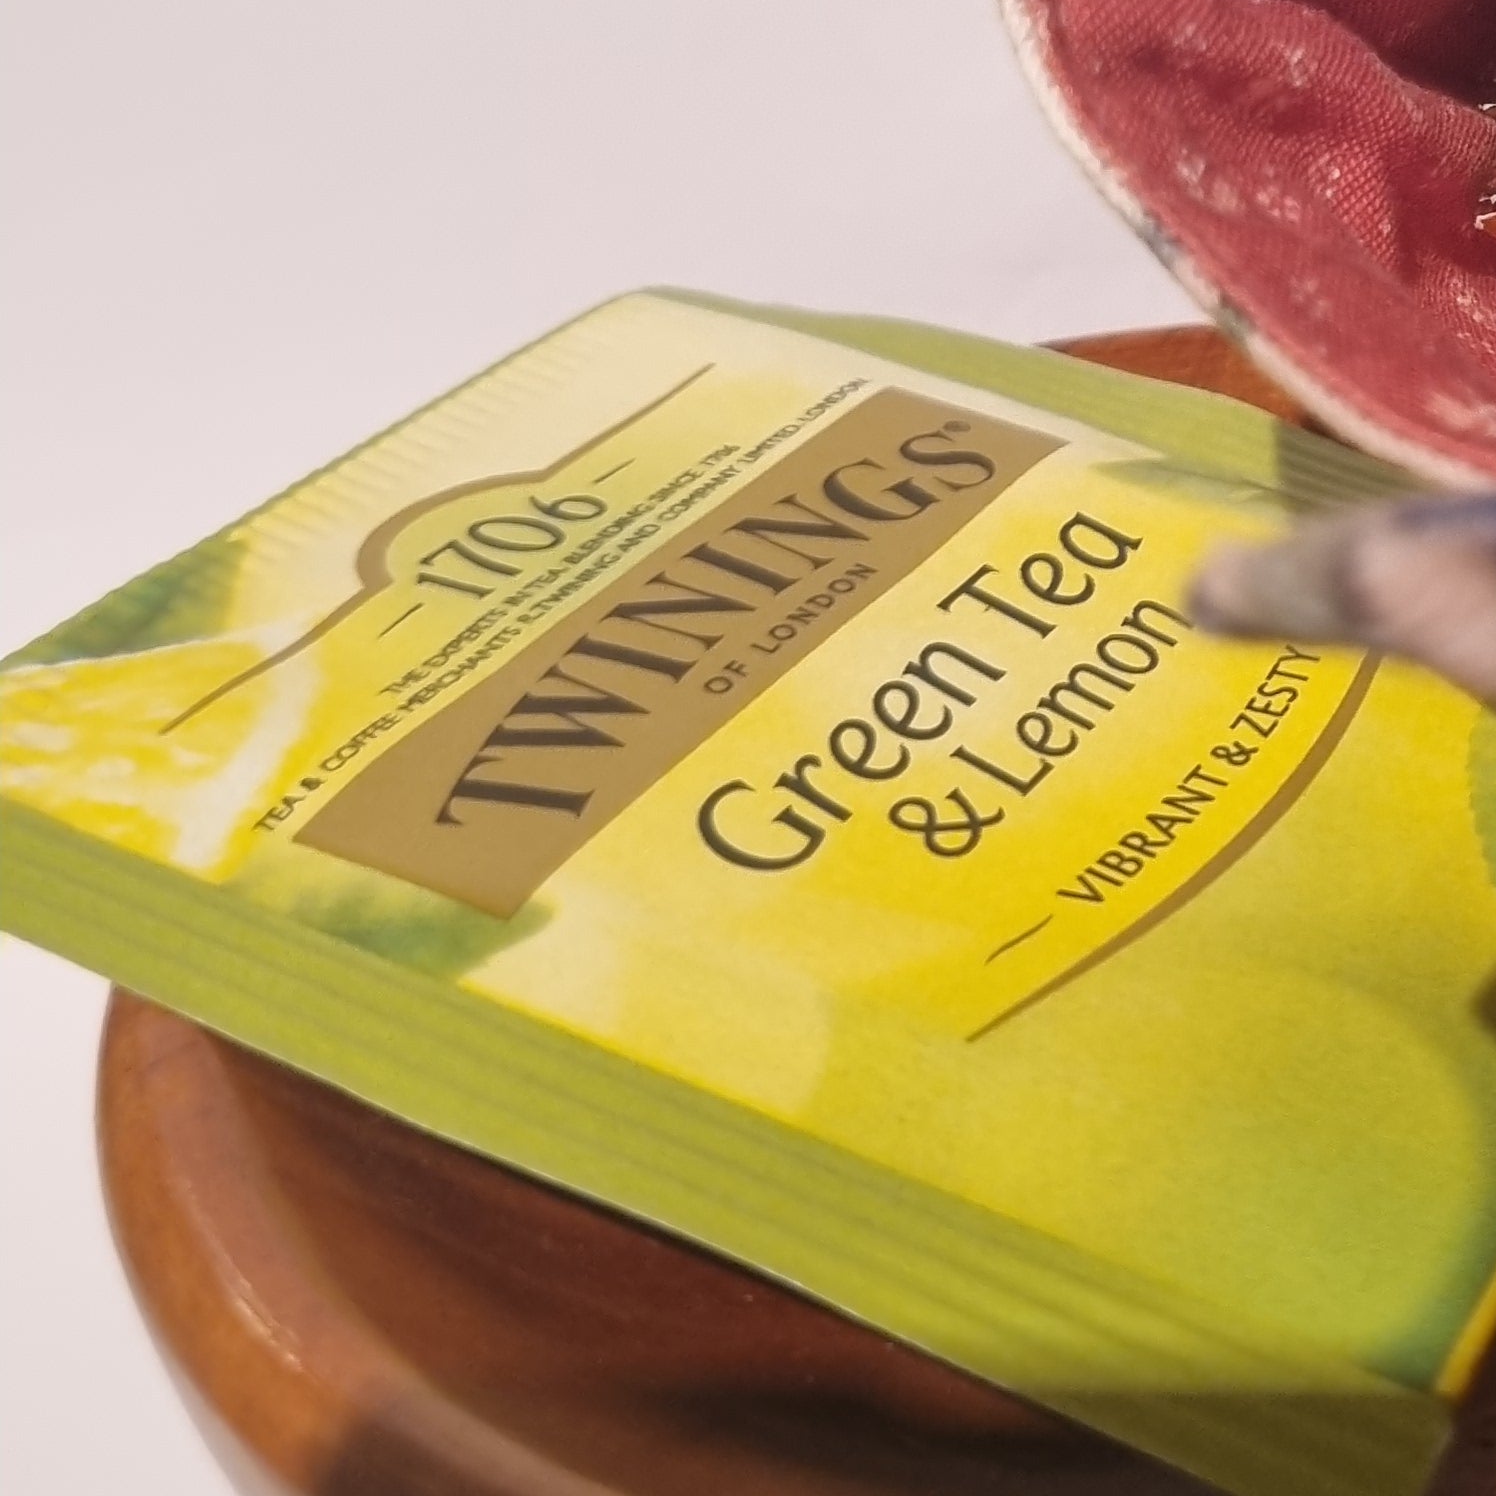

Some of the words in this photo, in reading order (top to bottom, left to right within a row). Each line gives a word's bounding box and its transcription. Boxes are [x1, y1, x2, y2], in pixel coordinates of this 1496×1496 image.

[379, 668, 430, 695] THE
[424, 607, 507, 668] EXPERTS
[502, 586, 528, 607] IN
[523, 567, 564, 600] TEA
[564, 503, 653, 565] BLENDING
[648, 469, 700, 506] SINCE
[417, 492, 608, 600] 1706
[434, 428, 997, 827] TWININGS
[704, 661, 750, 695] OF
[752, 561, 879, 656] LONDON
[252, 795, 305, 833] TEA
[300, 776, 325, 793] &
[320, 712, 402, 772] COFFEE
[398, 626, 522, 717] MERCHANTS
[618, 521, 662, 554] AND
[656, 465, 743, 524] COMPANY
[697, 640, 1008, 872] Green
[936, 510, 1145, 639] Tea
[949, 598, 1198, 798] Lemon
[1229, 644, 1322, 740] ZESTY
[1055, 763, 1230, 905] VIBRANT
[1208, 739, 1261, 770] &
